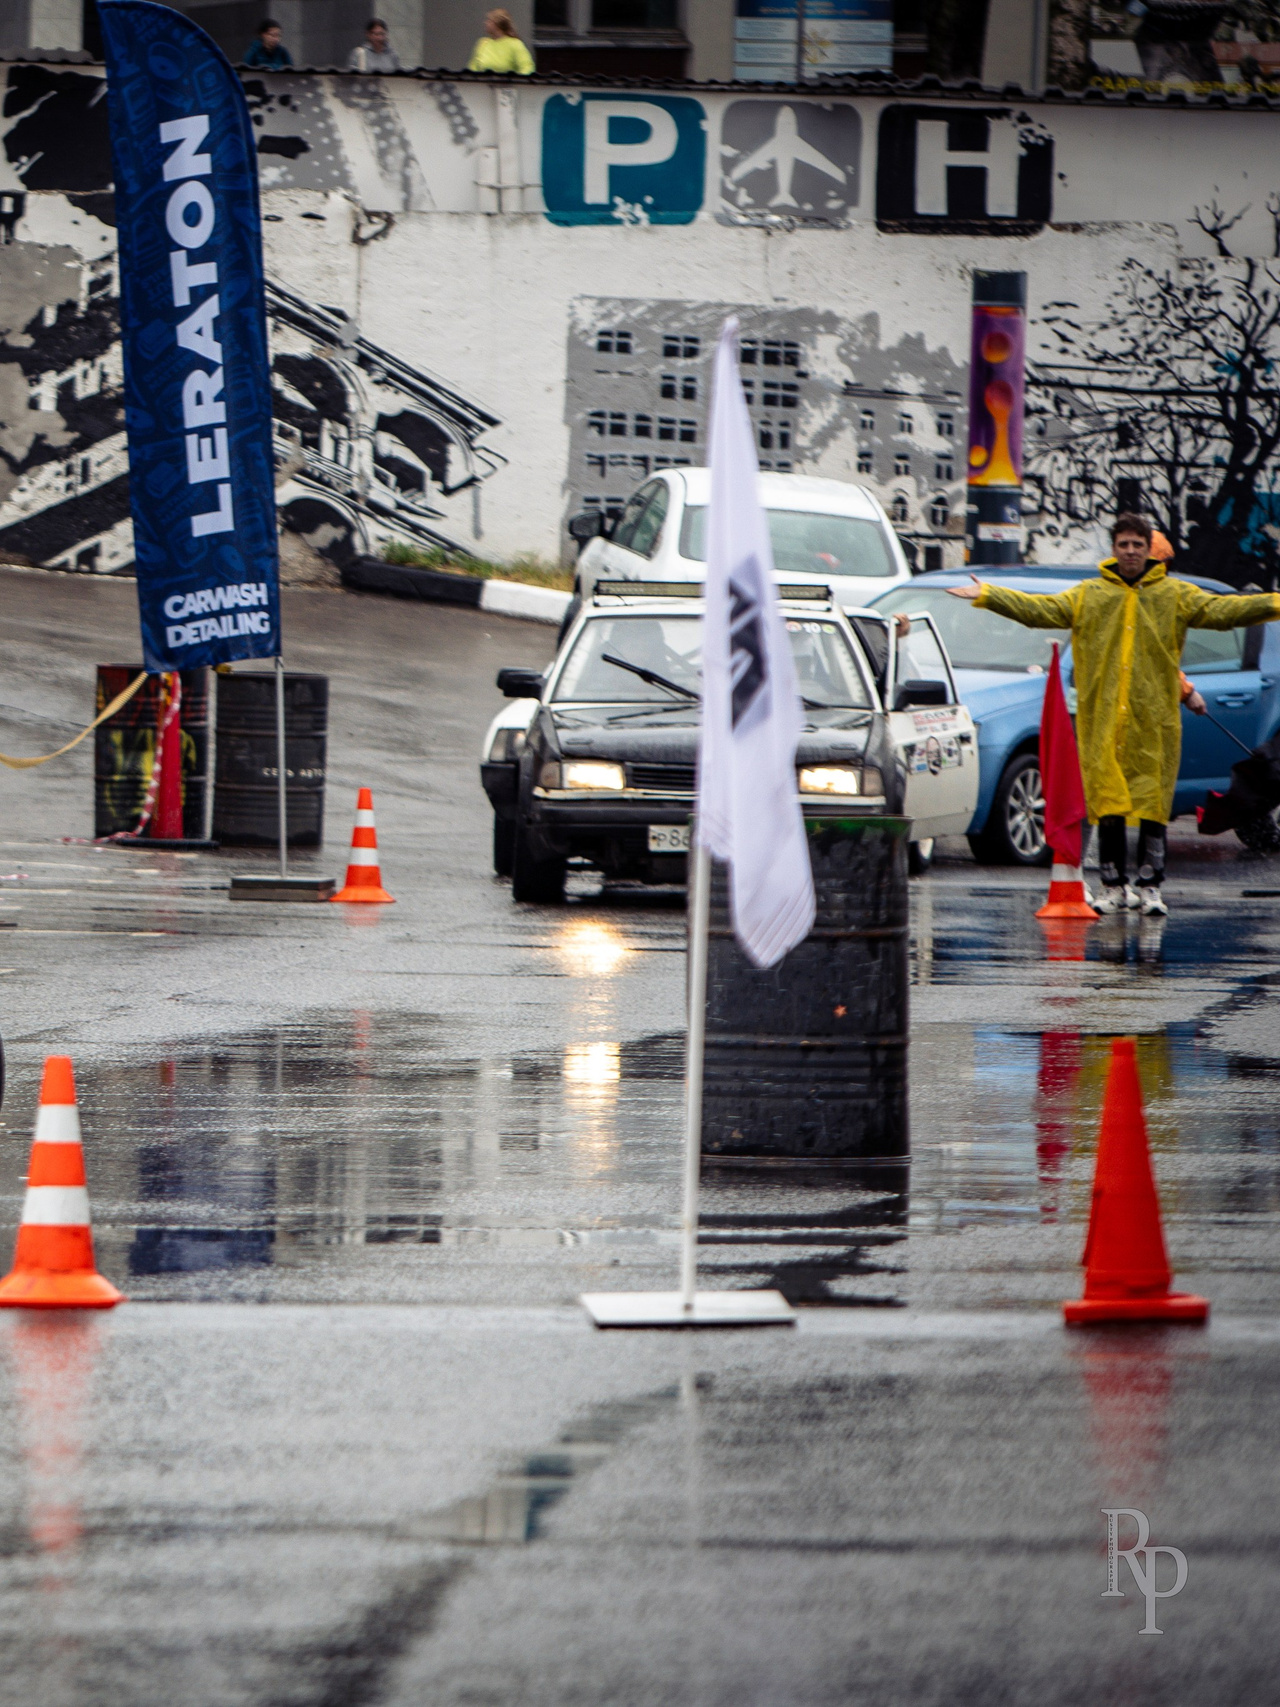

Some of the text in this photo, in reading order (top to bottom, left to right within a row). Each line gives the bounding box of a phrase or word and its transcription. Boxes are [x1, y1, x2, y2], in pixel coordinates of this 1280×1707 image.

[583, 100, 679, 204] P
[915, 118, 1018, 217] H
[158, 114, 234, 538] LERATON
[164, 582, 269, 619] CARWASH
[166, 611, 271, 648] DETAILING
[261, 766, 295, 778] СЕЬ
